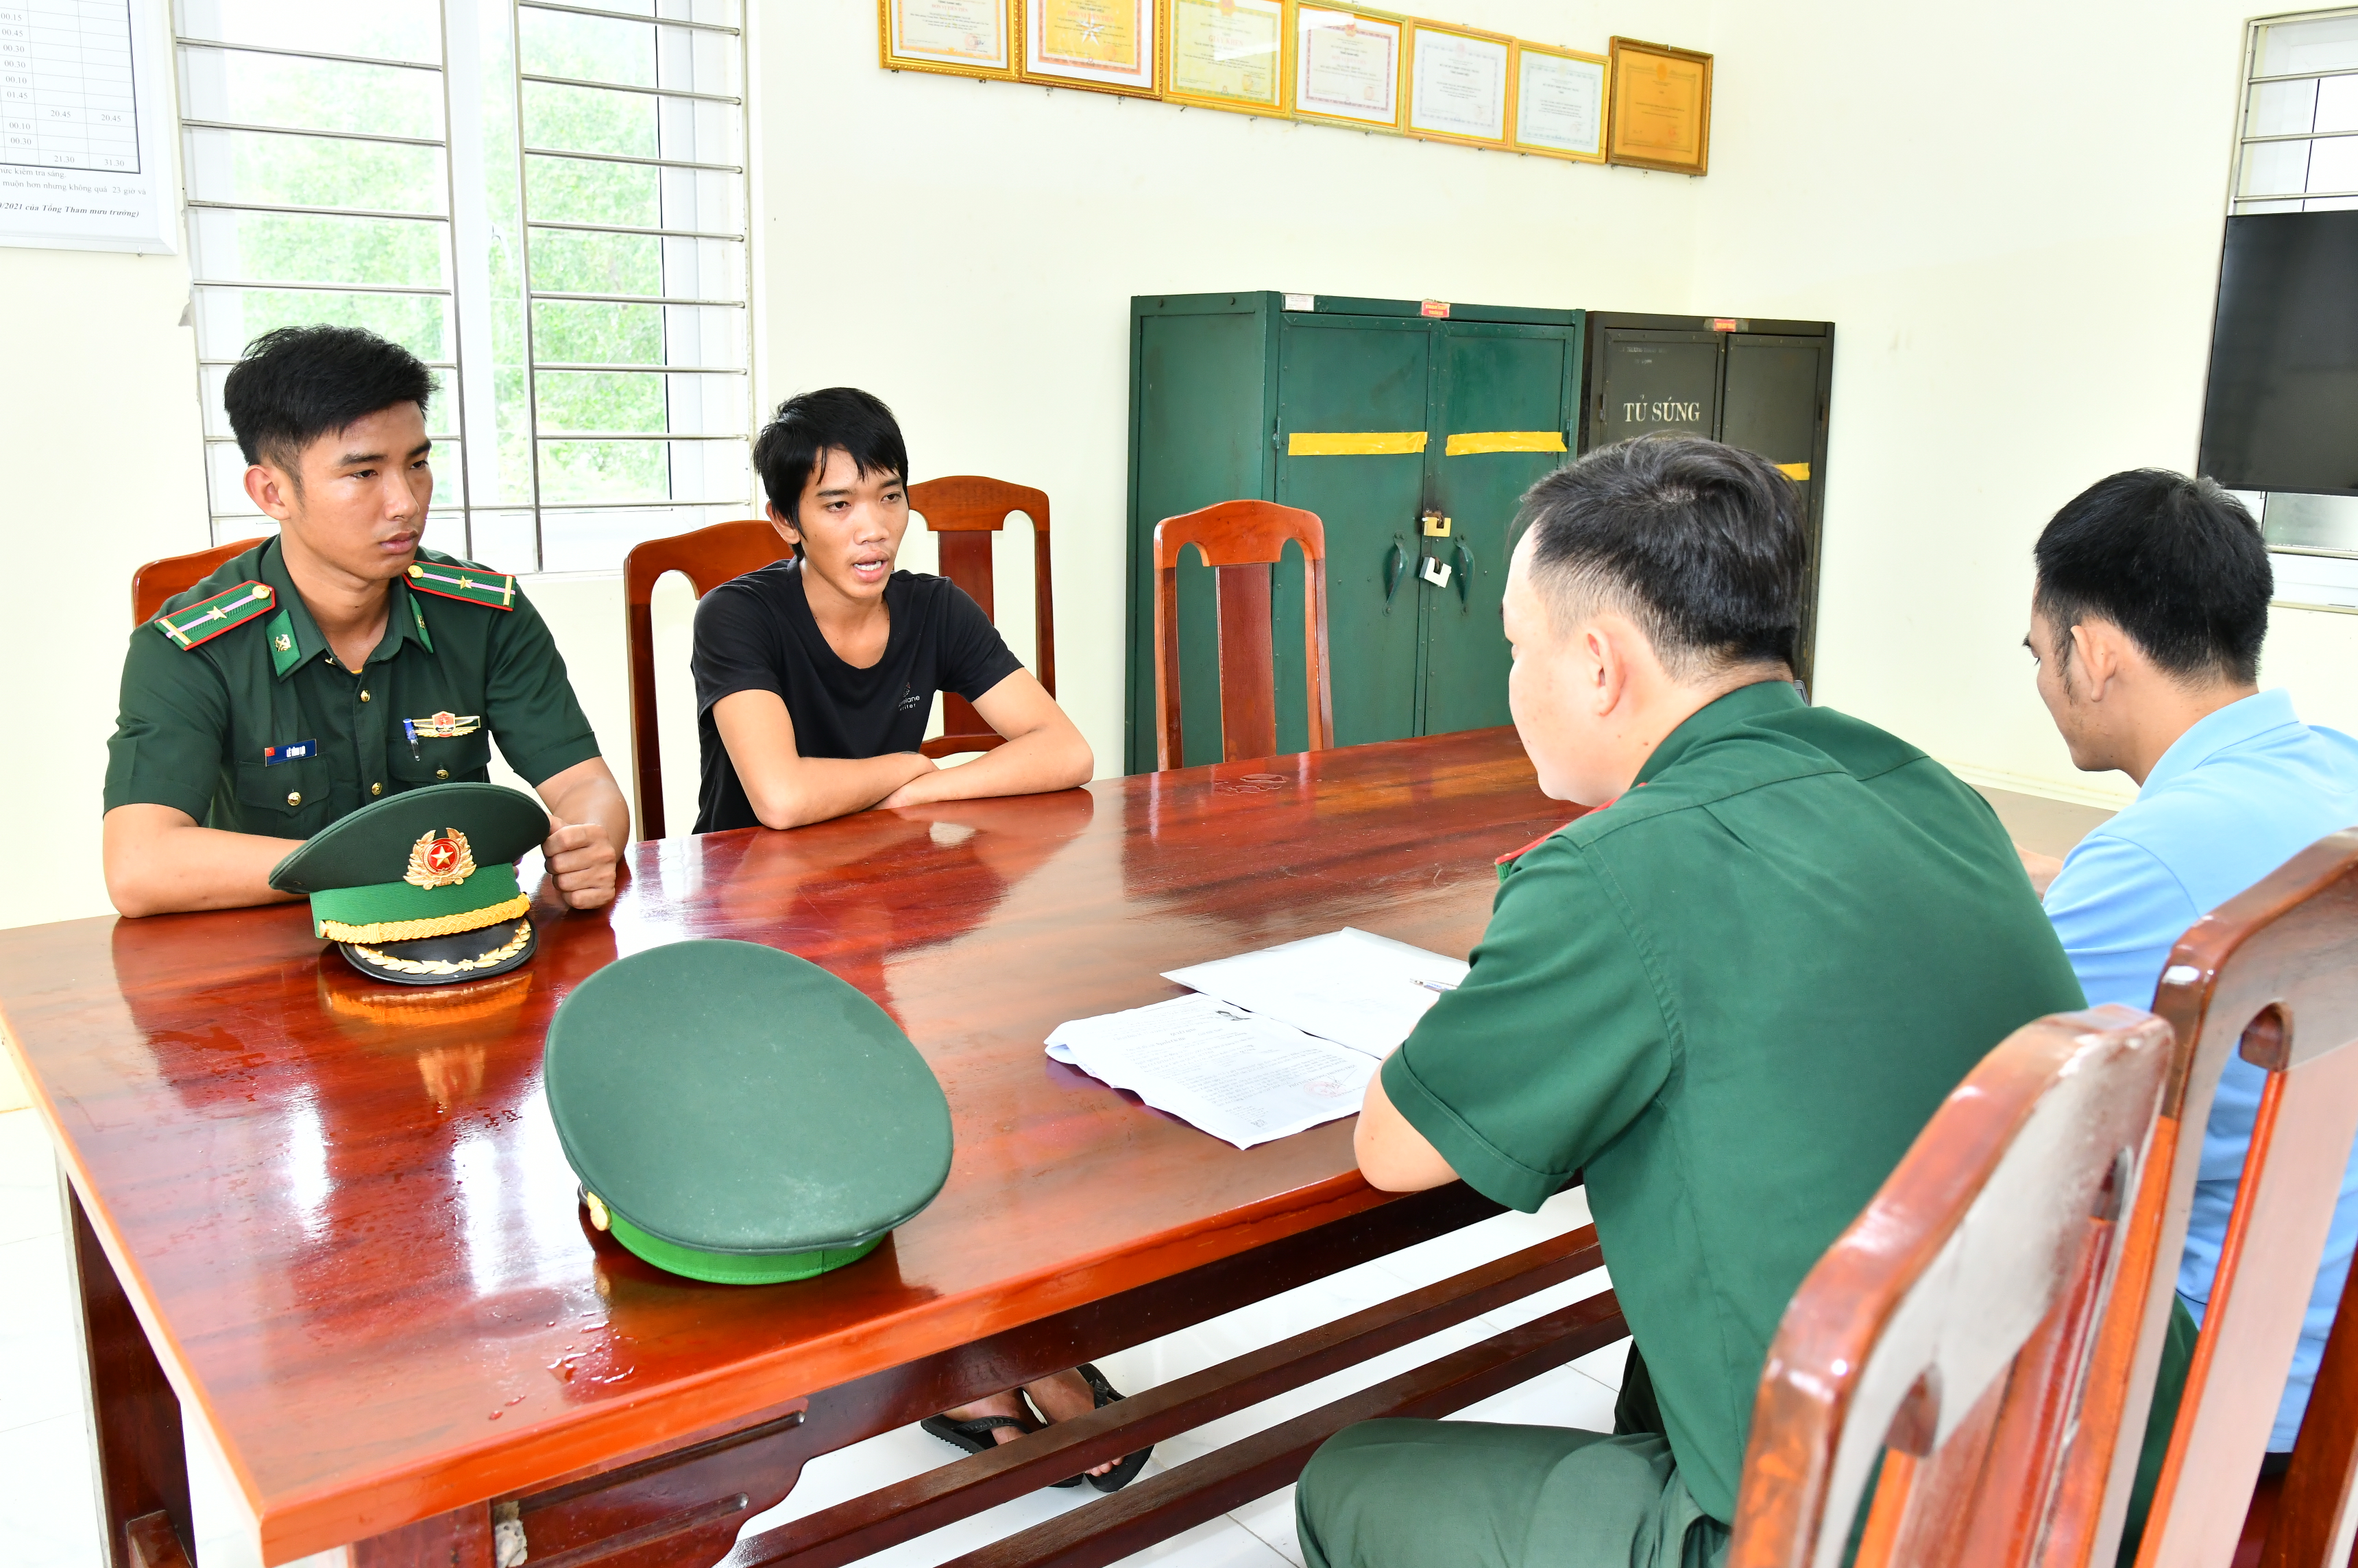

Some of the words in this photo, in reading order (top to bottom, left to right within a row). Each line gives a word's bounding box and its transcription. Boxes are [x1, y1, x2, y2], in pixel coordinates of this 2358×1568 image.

[1, 13, 22, 21] 00.15
[2, 29, 23, 37] 00.45
[3, 45, 25, 53] 00.30
[4, 60, 26, 69] 00.30
[5, 76, 27, 84] 00.10
[7, 91, 28, 99] 01.45
[51, 110, 71, 119] 20.45
[101, 114, 122, 122] 20.45
[9, 122, 31, 130] 00.10
[10, 137, 32, 145] 00.30
[54, 155, 75, 163] 21.30
[104, 158, 125, 167] 31.30
[14, 167, 34, 175] kiểm
[47, 170, 66, 180] sáng.
[43, 182, 67, 192] nhưng
[69, 184, 92, 193] không
[94, 186, 108, 194] quá
[123, 187, 136, 196] giờ
[42, 203, 62, 214] Tổng
[65, 206, 87, 214] Tham
[110, 209, 139, 218] trưởng)
[1622, 394, 1648, 422] TỦ
[1651, 395, 1701, 422] SÚNG
